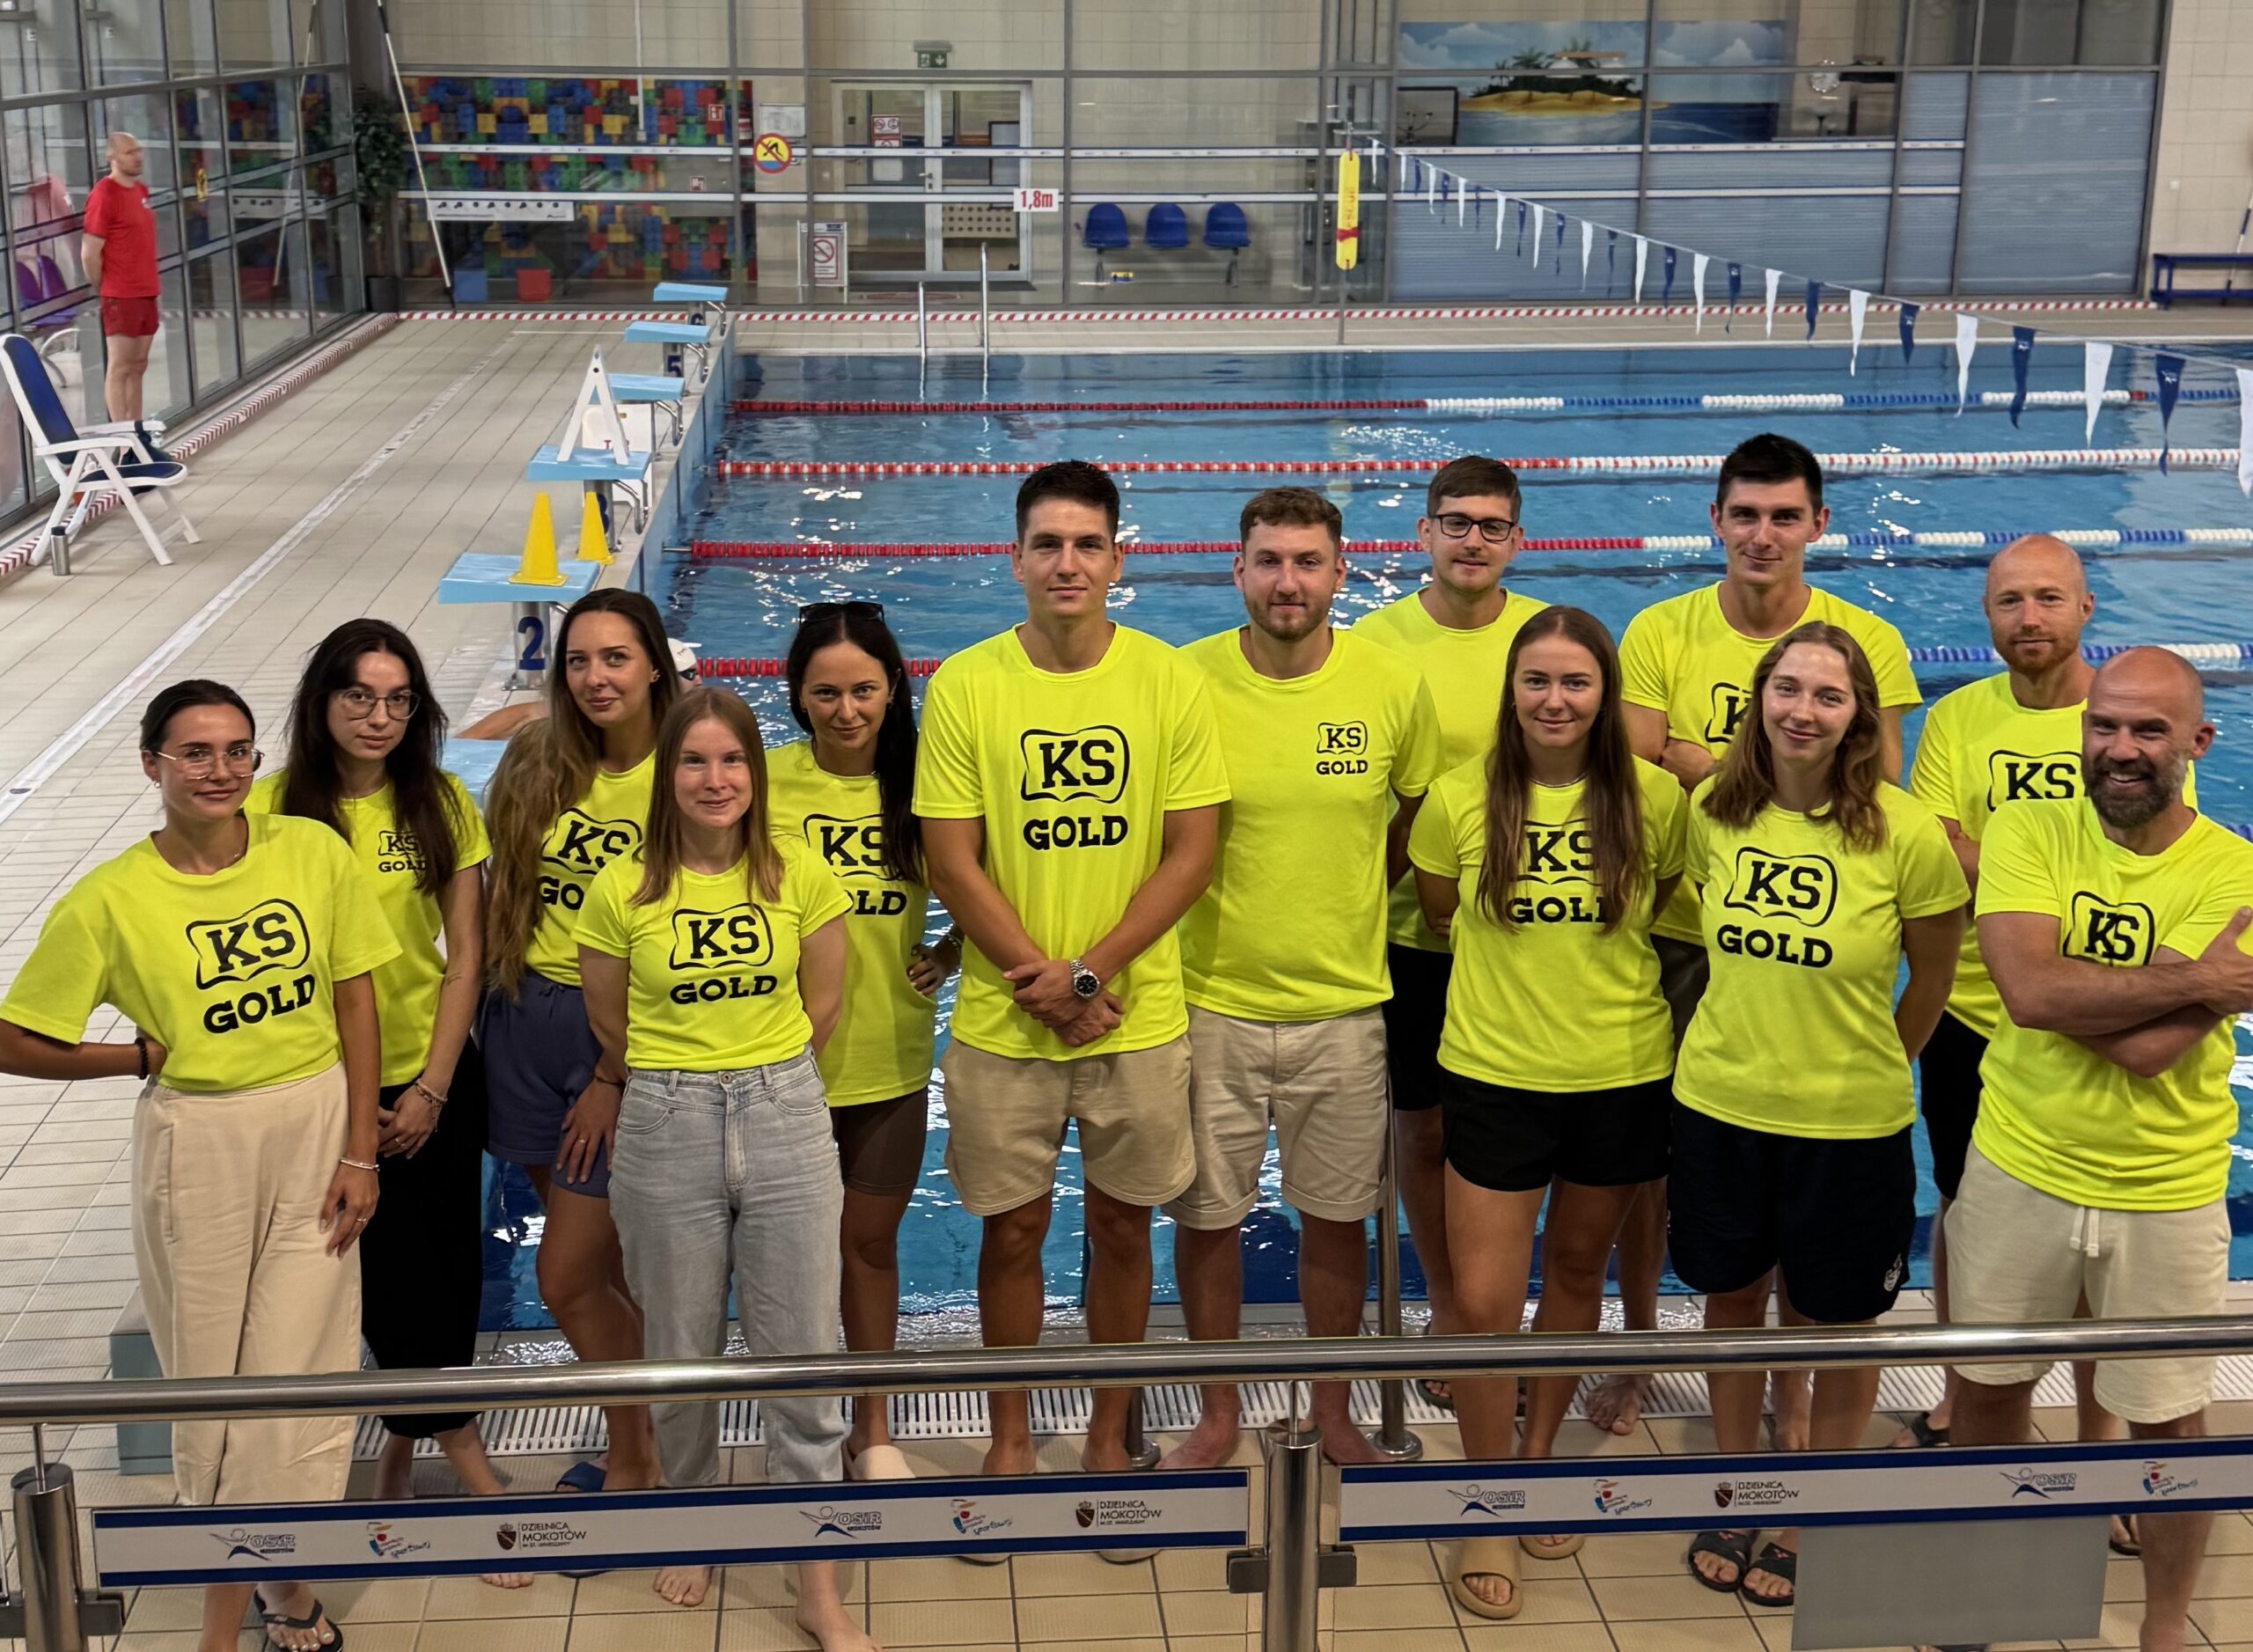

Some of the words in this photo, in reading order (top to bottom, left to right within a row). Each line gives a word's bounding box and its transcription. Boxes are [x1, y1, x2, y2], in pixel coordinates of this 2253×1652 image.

[1021, 190, 1053, 210] 1,8m
[667, 355, 681, 378] 5
[517, 616, 546, 670] 2
[1722, 695, 1753, 735] K
[1326, 727, 1361, 748] KS
[1038, 739, 1115, 789] KS
[1316, 760, 1369, 775] GOLD
[2005, 762, 2076, 801] KS
[386, 835, 418, 852] KS
[557, 819, 631, 869] KS
[1023, 815, 1128, 850] GOLD
[1525, 830, 1595, 872] KS
[537, 876, 584, 910] GO
[845, 889, 907, 915] LD
[1744, 860, 1824, 910] KS
[206, 912, 296, 973] KS
[688, 914, 760, 959] KS
[1717, 924, 1833, 968] GOLD
[2085, 907, 2140, 962] KS
[203, 973, 315, 1033] GOLD
[670, 975, 778, 1004] GOLD
[1099, 1500, 1146, 1509] DZIELNICA
[521, 1522, 569, 1531] DZIELNICA
[522, 1529, 587, 1542] MOKOTÓW
